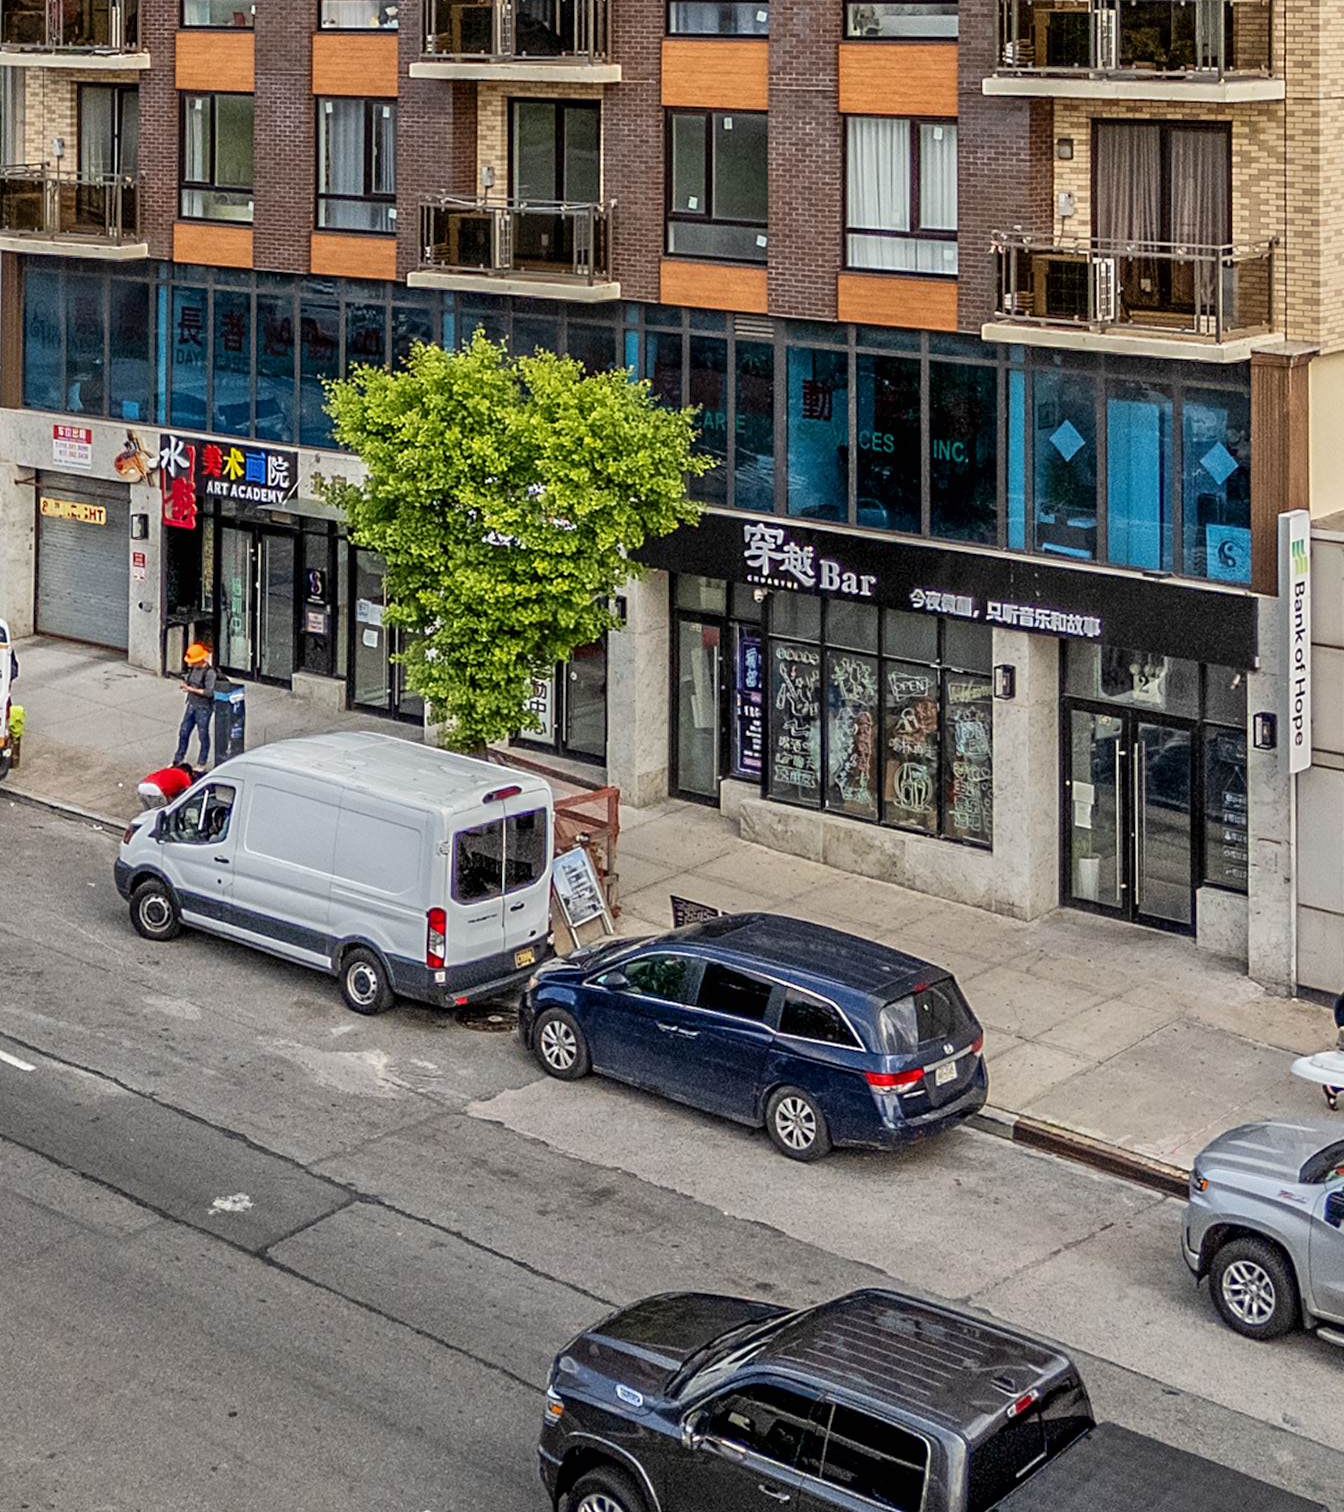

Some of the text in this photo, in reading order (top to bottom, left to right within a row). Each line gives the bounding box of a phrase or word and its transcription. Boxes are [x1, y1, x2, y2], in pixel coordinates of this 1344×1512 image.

[176, 348, 203, 366] DAY
[933, 439, 969, 464] INC.
[206, 480, 285, 503] ART ACADEMY
[743, 522, 817, 587] 穿越
[819, 559, 877, 597] Bar
[1292, 581, 1307, 747] Bank of Hope
[894, 680, 924, 692] OPEN
